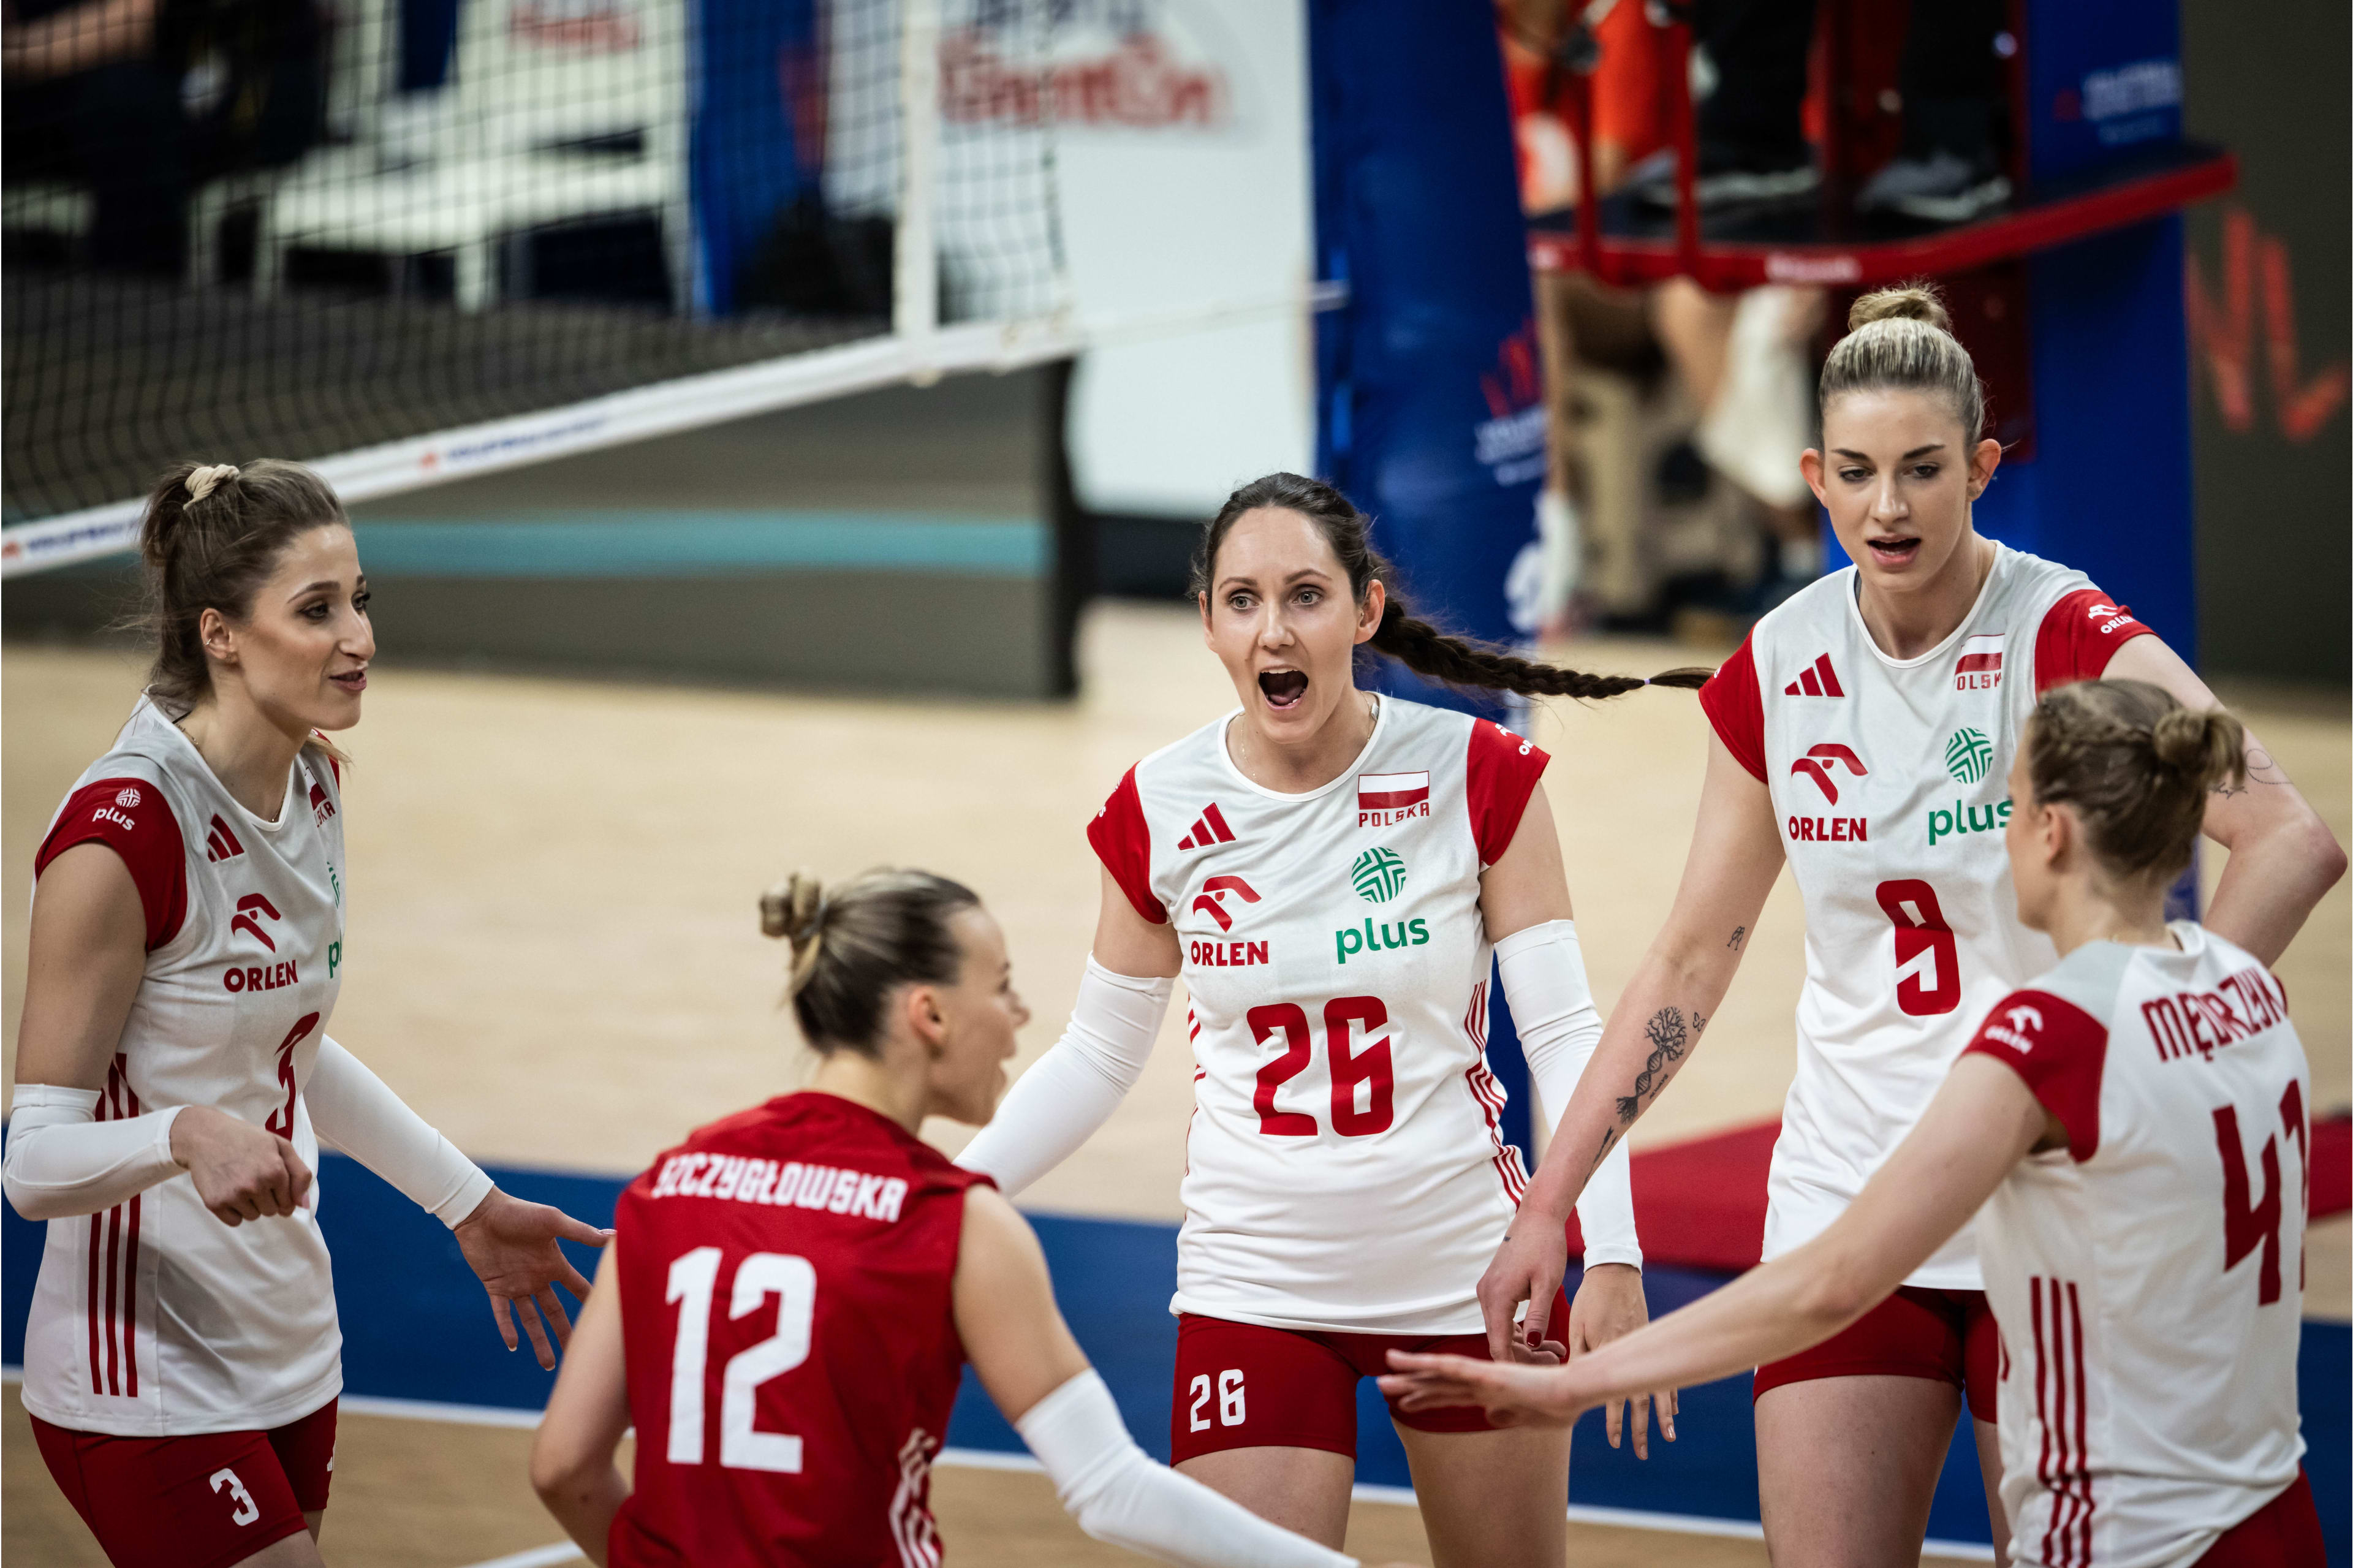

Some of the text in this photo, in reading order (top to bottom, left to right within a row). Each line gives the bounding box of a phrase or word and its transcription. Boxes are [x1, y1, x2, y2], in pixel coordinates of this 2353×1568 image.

[92, 807, 135, 831] plus
[1358, 802, 1430, 828] POLSKA
[1789, 816, 1868, 842] ORLEN
[1928, 799, 2014, 846] plus
[1191, 940, 1269, 967] ORLEN
[1336, 917, 1430, 964] plus
[1876, 879, 1961, 1017] 9
[223, 959, 299, 993] ORLEN
[264, 1011, 320, 1143] 3
[1246, 996, 1395, 1137] 26
[665, 1245, 817, 1475] 12
[1189, 1369, 1246, 1433] 26
[210, 1468, 260, 1526] 3
